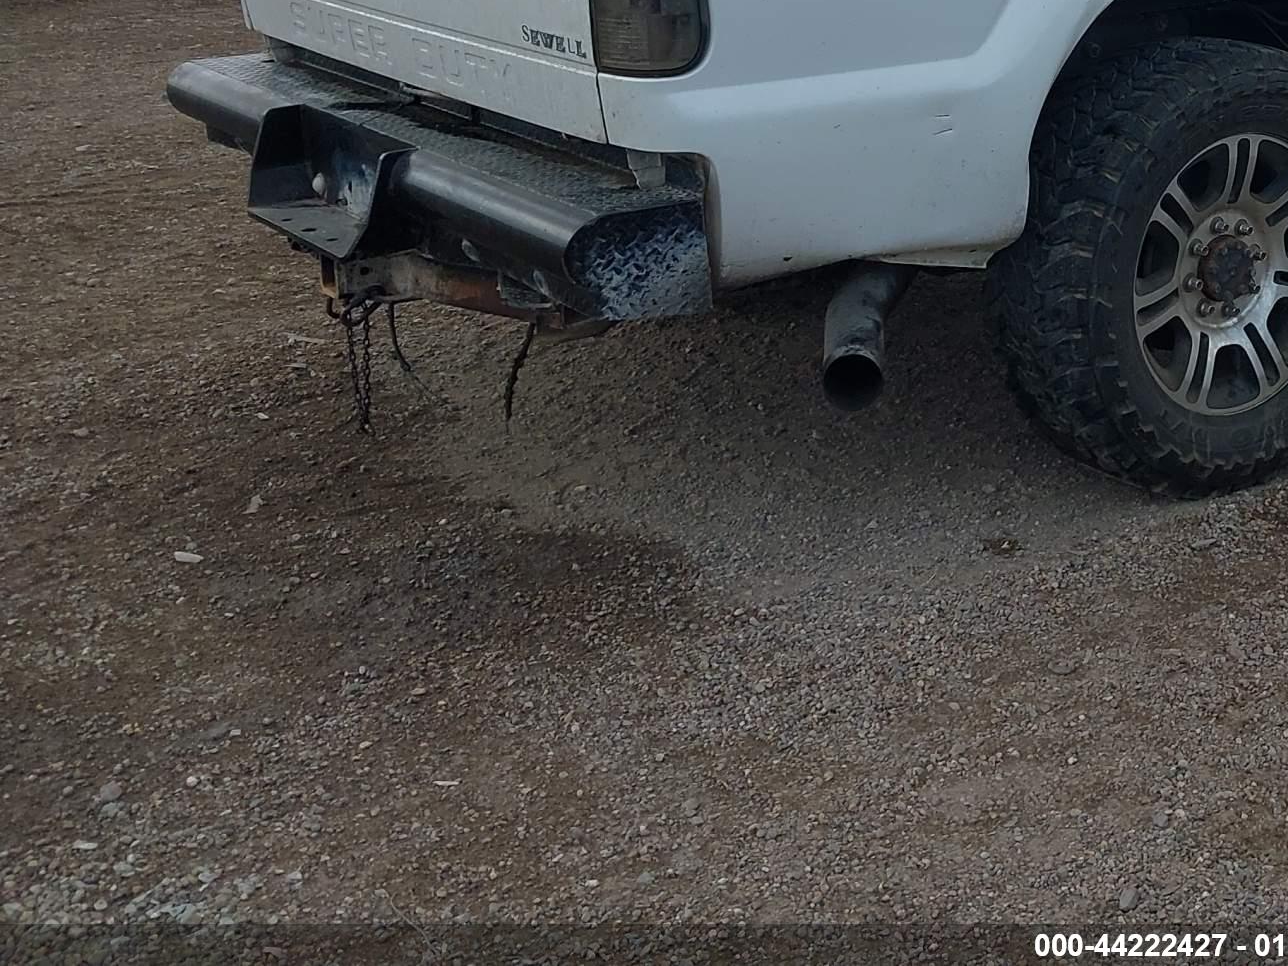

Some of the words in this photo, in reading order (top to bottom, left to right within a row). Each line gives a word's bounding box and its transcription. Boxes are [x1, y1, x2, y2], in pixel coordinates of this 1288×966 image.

[289, 1, 393, 66] SUPER
[411, 37, 513, 102] DUTY
[521, 24, 587, 59] SEWELL
